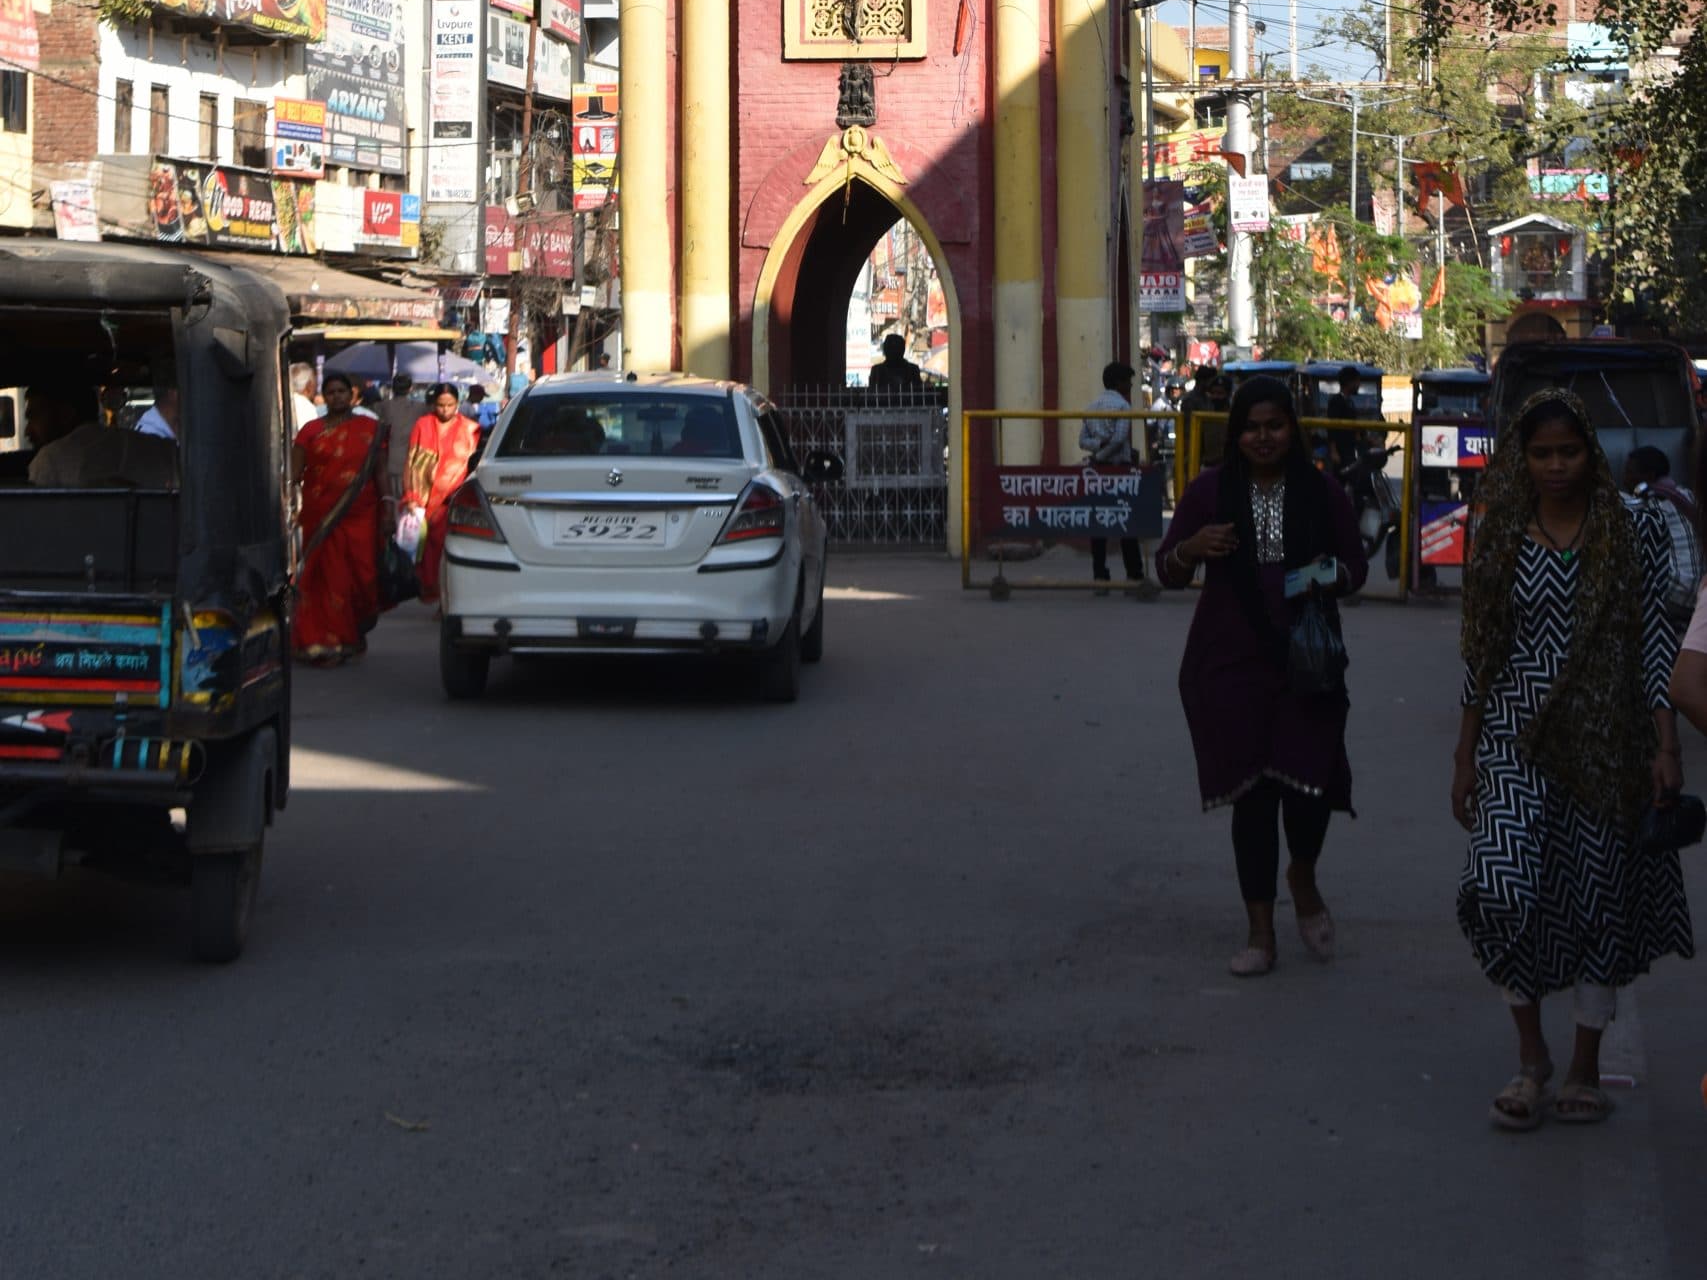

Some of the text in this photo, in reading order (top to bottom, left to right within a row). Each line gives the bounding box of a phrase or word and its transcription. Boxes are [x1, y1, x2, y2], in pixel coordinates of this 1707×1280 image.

[437, 19, 473, 30] Livpure
[442, 33, 466, 45] KENT
[327, 88, 387, 122] ARYANS
[371, 201, 393, 225] VIP
[551, 232, 573, 254] BANK
[1000, 467, 1142, 497] यातायात नियमों
[1002, 499, 1132, 533] का पालन करें
[561, 523, 658, 540] 5922
